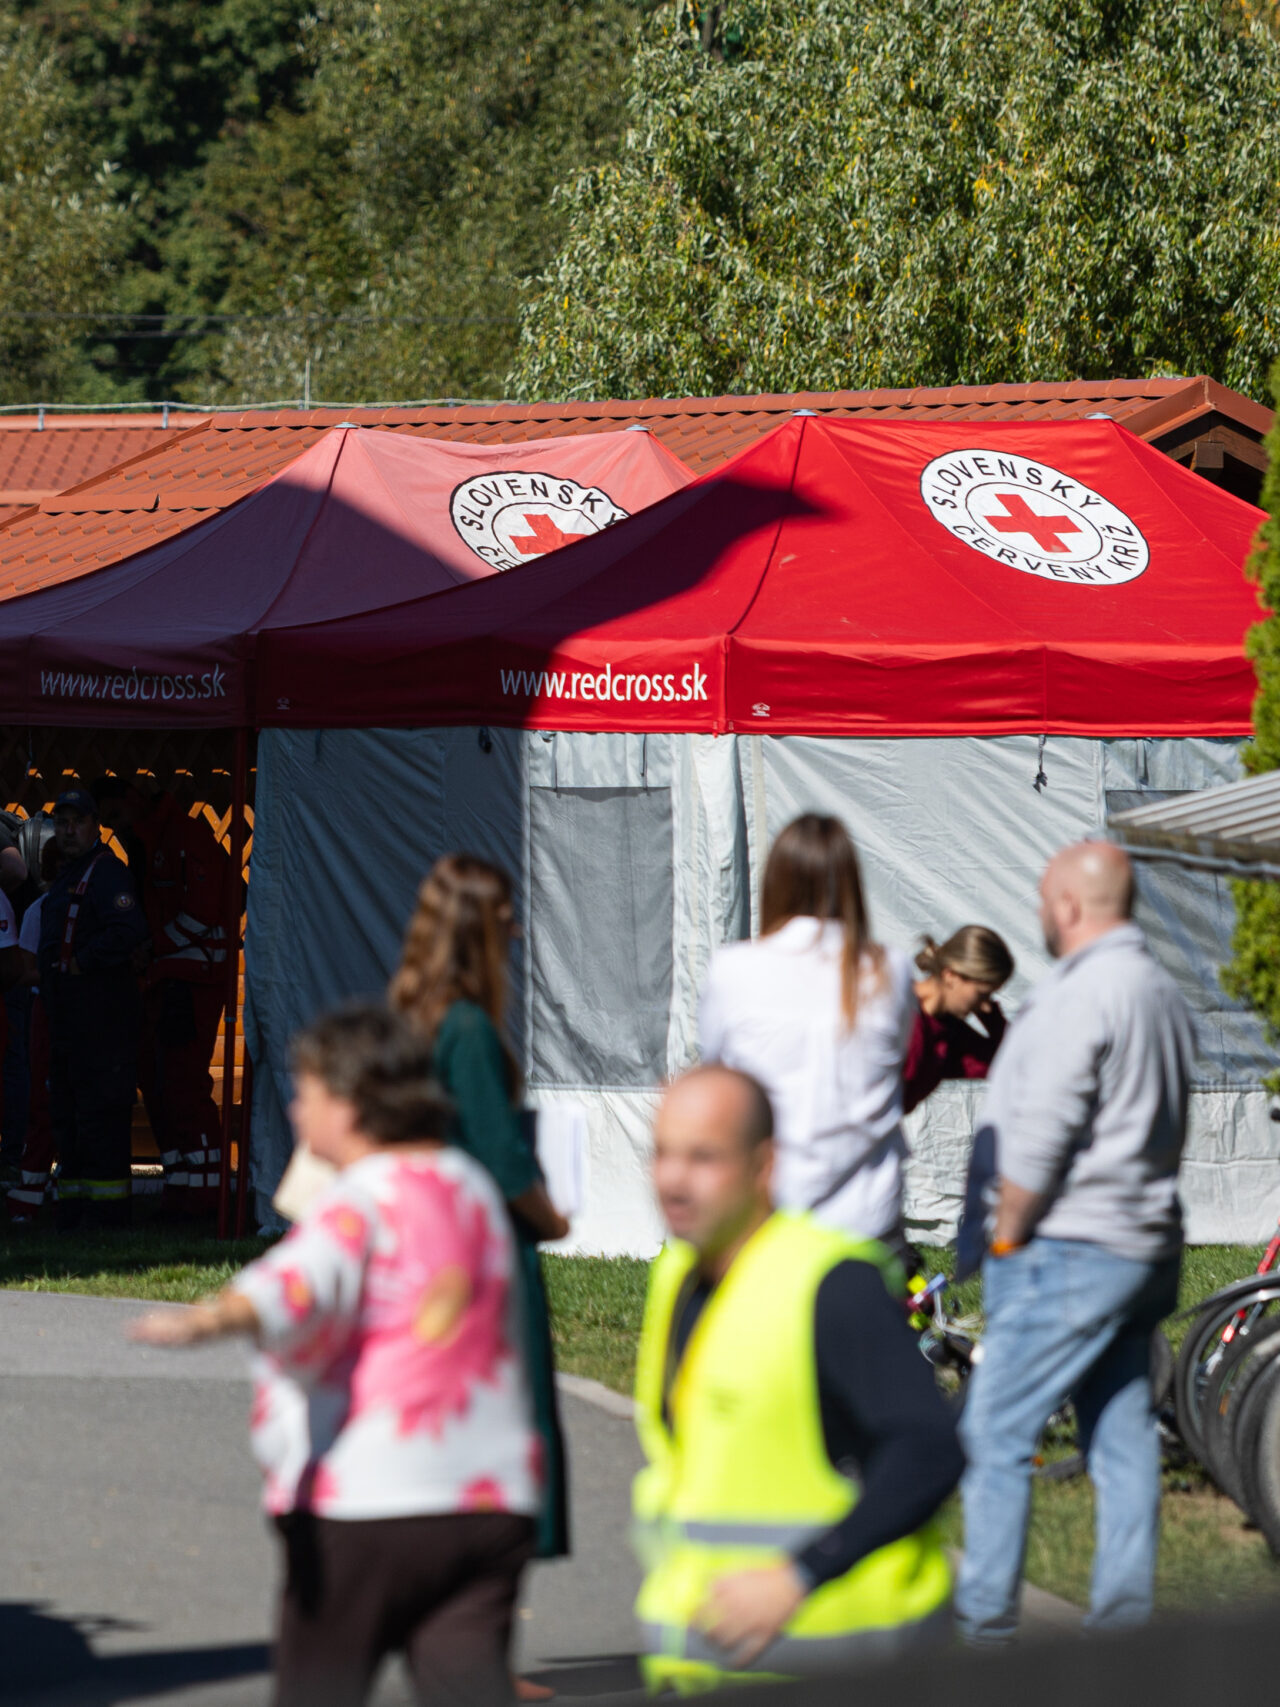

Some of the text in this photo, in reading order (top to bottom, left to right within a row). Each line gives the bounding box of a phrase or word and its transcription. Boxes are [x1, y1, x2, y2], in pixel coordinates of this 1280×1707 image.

[932, 457, 1102, 509] SLOVENSKÝ
[953, 524, 1140, 580] ČERVENÝ KRÍŽ
[40, 663, 226, 700] www.redcross.sk
[500, 662, 708, 701] www.redcross.sk
